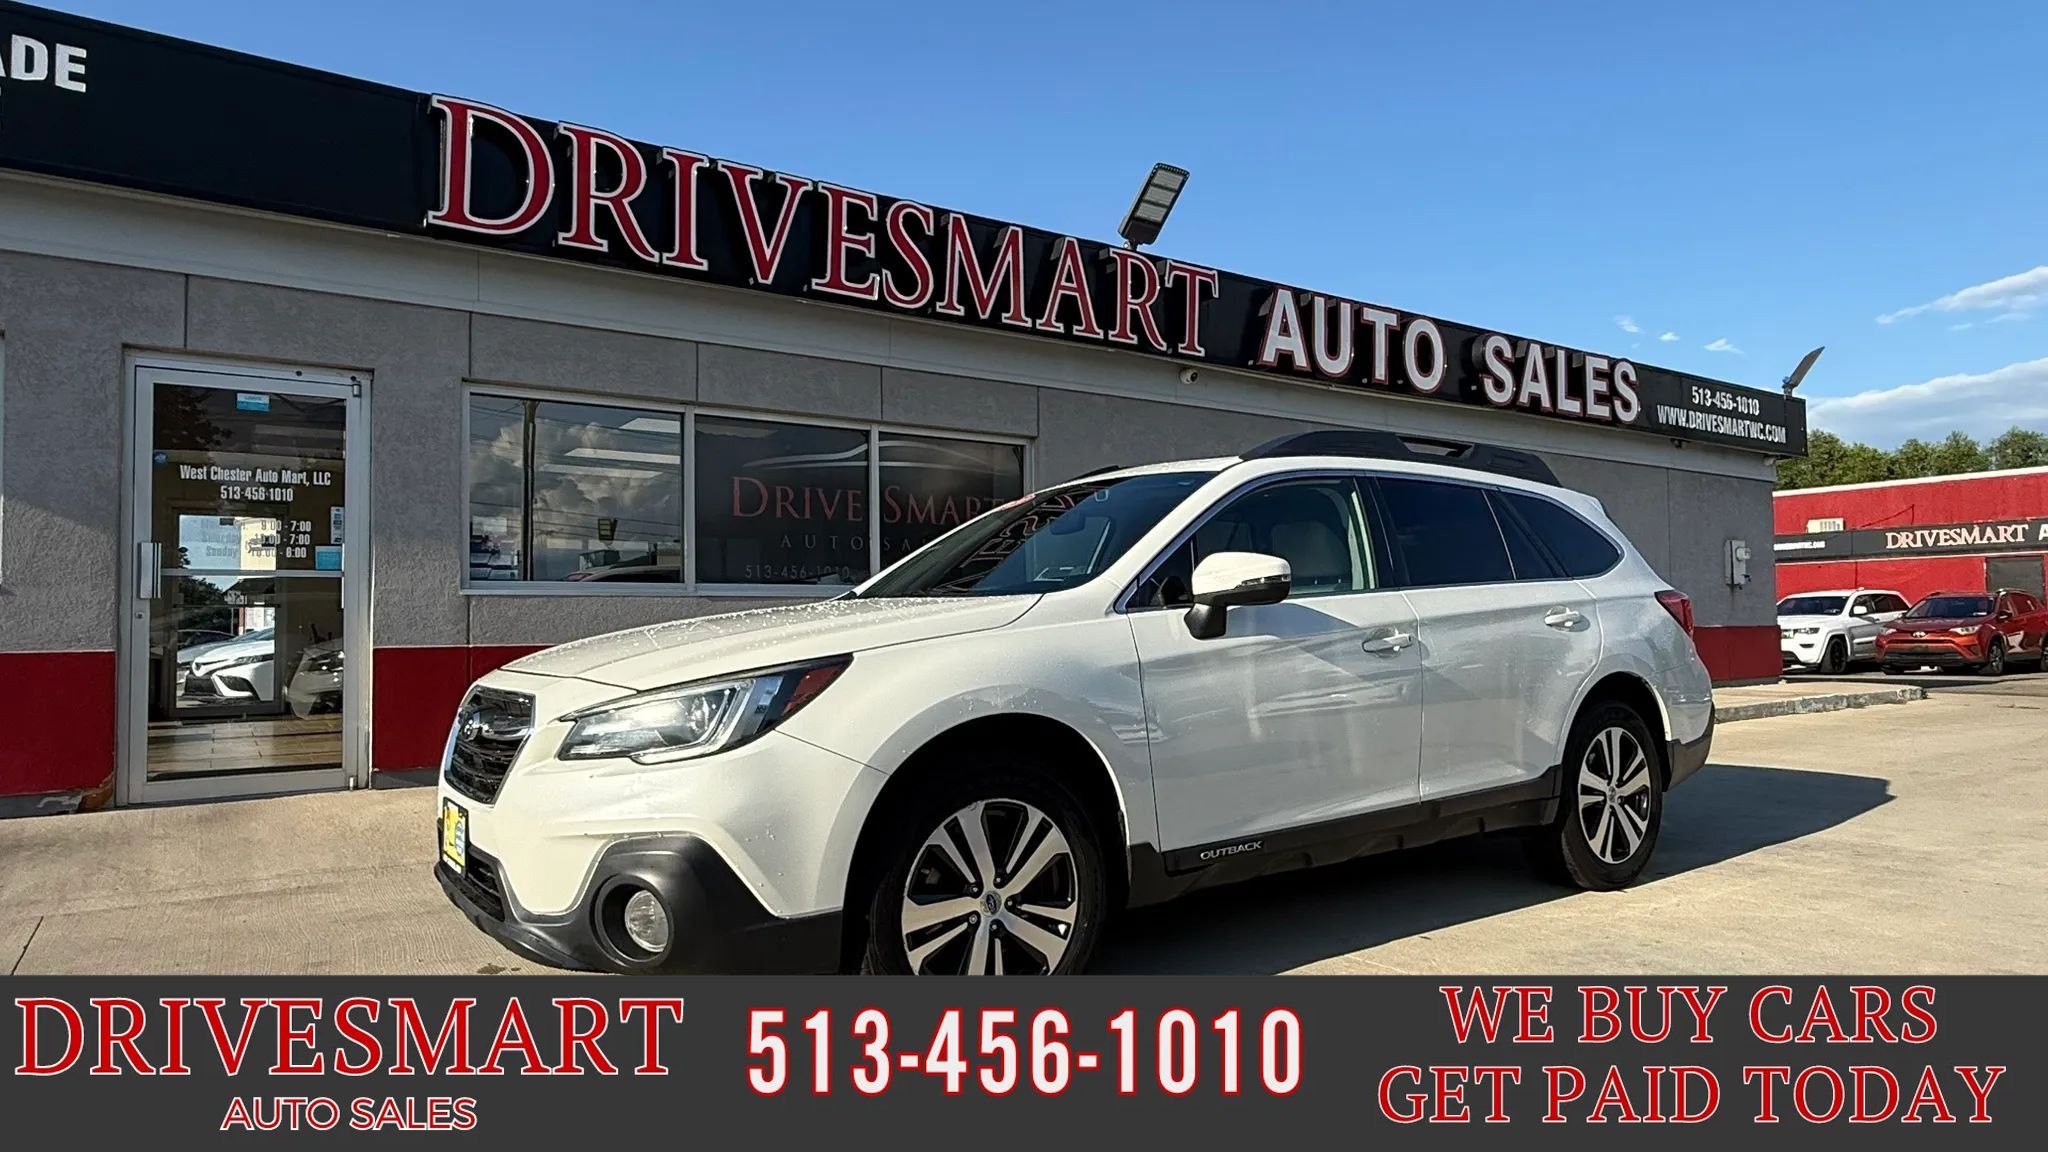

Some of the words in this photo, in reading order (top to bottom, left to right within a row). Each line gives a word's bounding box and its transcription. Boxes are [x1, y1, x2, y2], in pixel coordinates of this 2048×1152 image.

[0, 34, 87, 93] DE
[427, 94, 1219, 357] DRIVESMART
[1256, 286, 1447, 394] AUTO
[1480, 333, 1640, 425] SALES
[1691, 386, 1760, 416] 513-456-1010
[1657, 405, 1786, 444] WWW.DRIVESMARTWC.COM
[180, 464, 207, 480] West
[210, 466, 252, 482] Chester
[255, 468, 279, 483] Auto
[281, 470, 310, 487] Mart,
[313, 471, 331, 486] LLC
[219, 485, 294, 502] 513-456-1010
[290, 520, 312, 532] 7:00
[1885, 524, 2029, 549] DRIVESMART
[289, 533, 311, 545] 7:00
[780, 535, 864, 551] AUTO
[1200, 840, 1262, 860] OUTBACK
